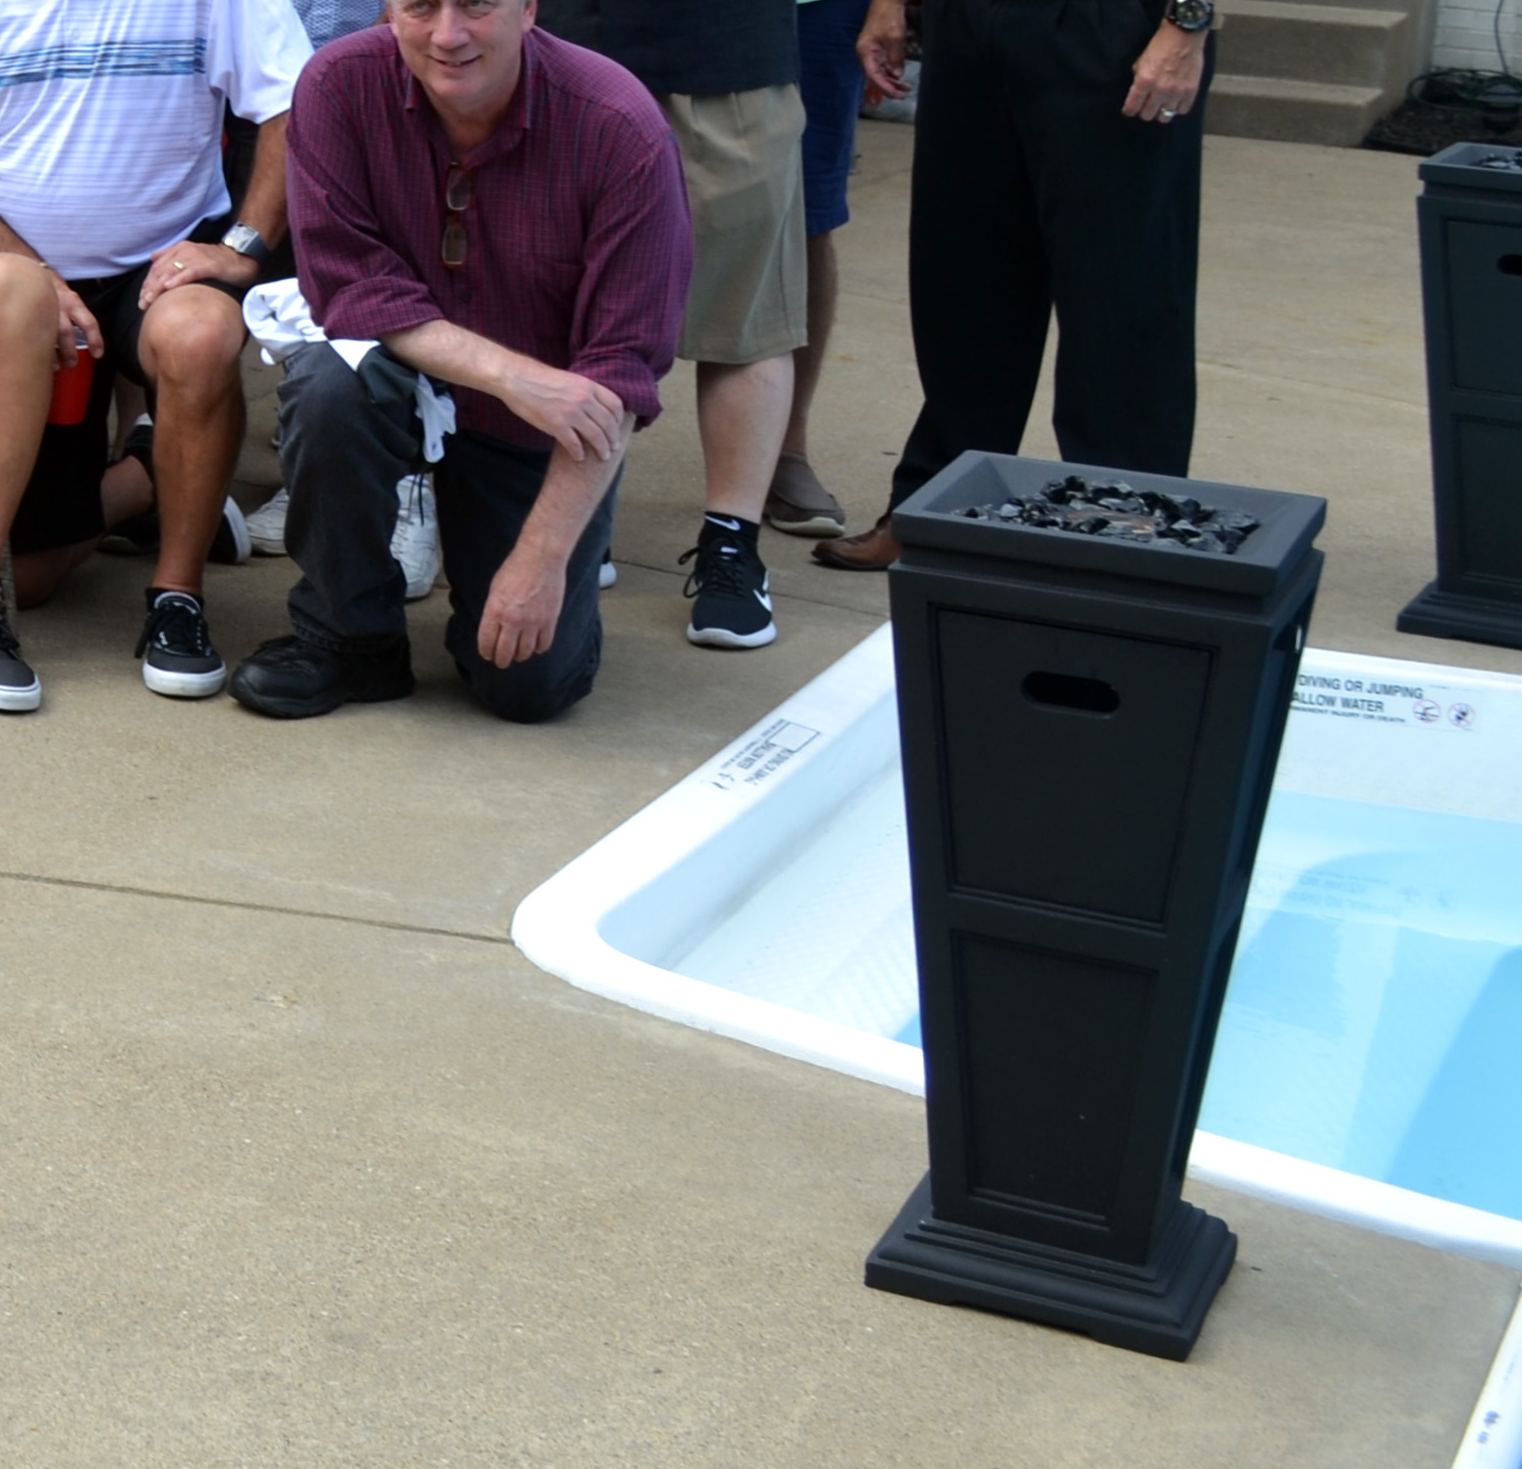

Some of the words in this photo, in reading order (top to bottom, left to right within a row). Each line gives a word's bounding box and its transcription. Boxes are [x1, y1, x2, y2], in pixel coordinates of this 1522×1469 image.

[1298, 674, 1341, 691] DIVING
[1344, 679, 1363, 692] OR
[1366, 682, 1424, 699] JUMPING
[1340, 696, 1384, 712] WATER
